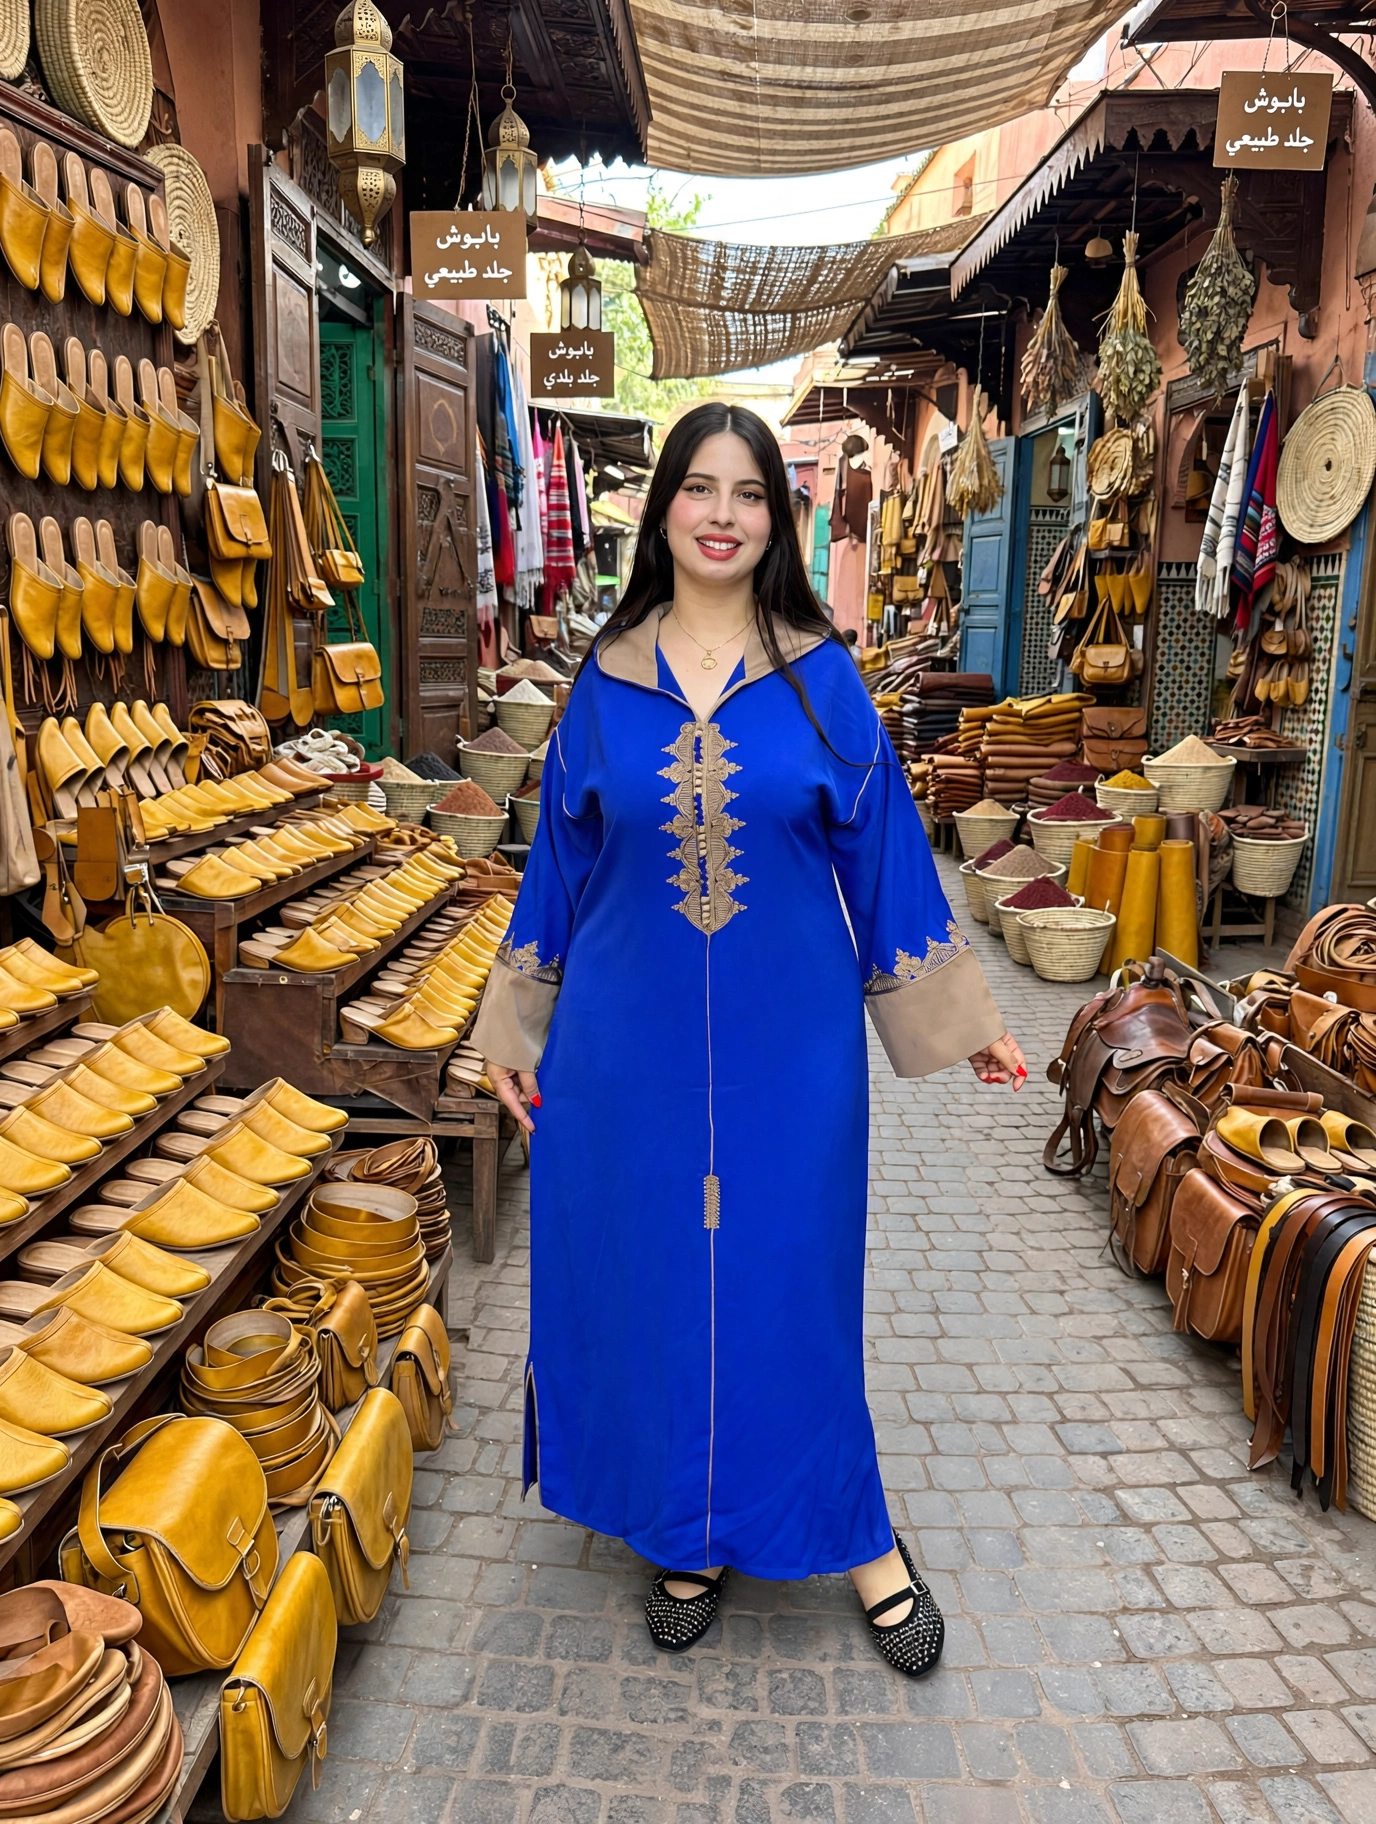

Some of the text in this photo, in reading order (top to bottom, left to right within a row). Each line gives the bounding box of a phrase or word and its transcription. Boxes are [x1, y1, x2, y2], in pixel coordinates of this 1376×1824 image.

[1244, 87, 1306, 114] بابوش
[1225, 126, 1315, 157] جلد طبيعي
[436, 223, 500, 250] بابوش
[424, 259, 513, 289] جلد طبيعي
[548, 340, 594, 360] بابوش
[543, 368, 600, 390] جلد بلدي
